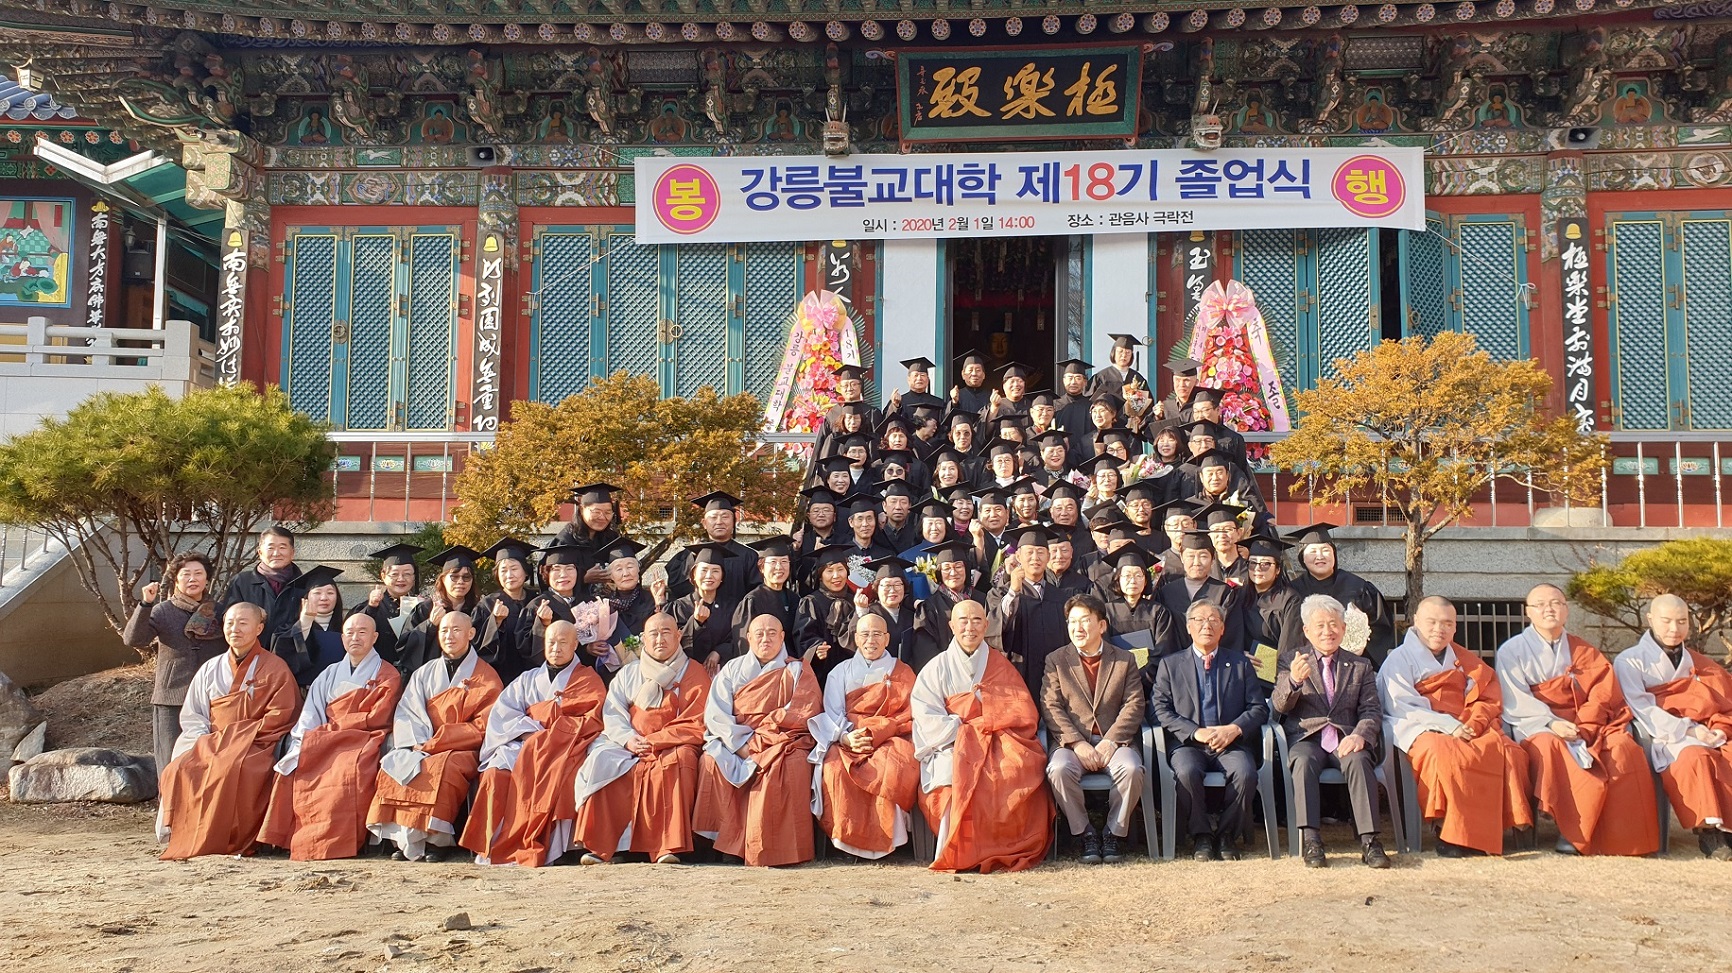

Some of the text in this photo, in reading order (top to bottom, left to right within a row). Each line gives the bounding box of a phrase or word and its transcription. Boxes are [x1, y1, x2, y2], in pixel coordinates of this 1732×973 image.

[665, 178, 706, 221] 봉
[740, 158, 1312, 211] 강릉불교대학 제18기 졸업식
[1345, 169, 1389, 205] 행
[862, 218, 888, 233] 일시
[901, 216, 945, 232] 2020년
[948, 216, 969, 231] 2월
[973, 216, 994, 231] 1일
[998, 215, 1035, 229] 14:00
[1067, 213, 1094, 228] 장소
[1108, 211, 1149, 227] 관음사
[1153, 210, 1194, 225] 극락전
[845, 328, 856, 360] 18기
[773, 330, 804, 412] 강릉 불교대학
[1267, 381, 1281, 410] 졸
